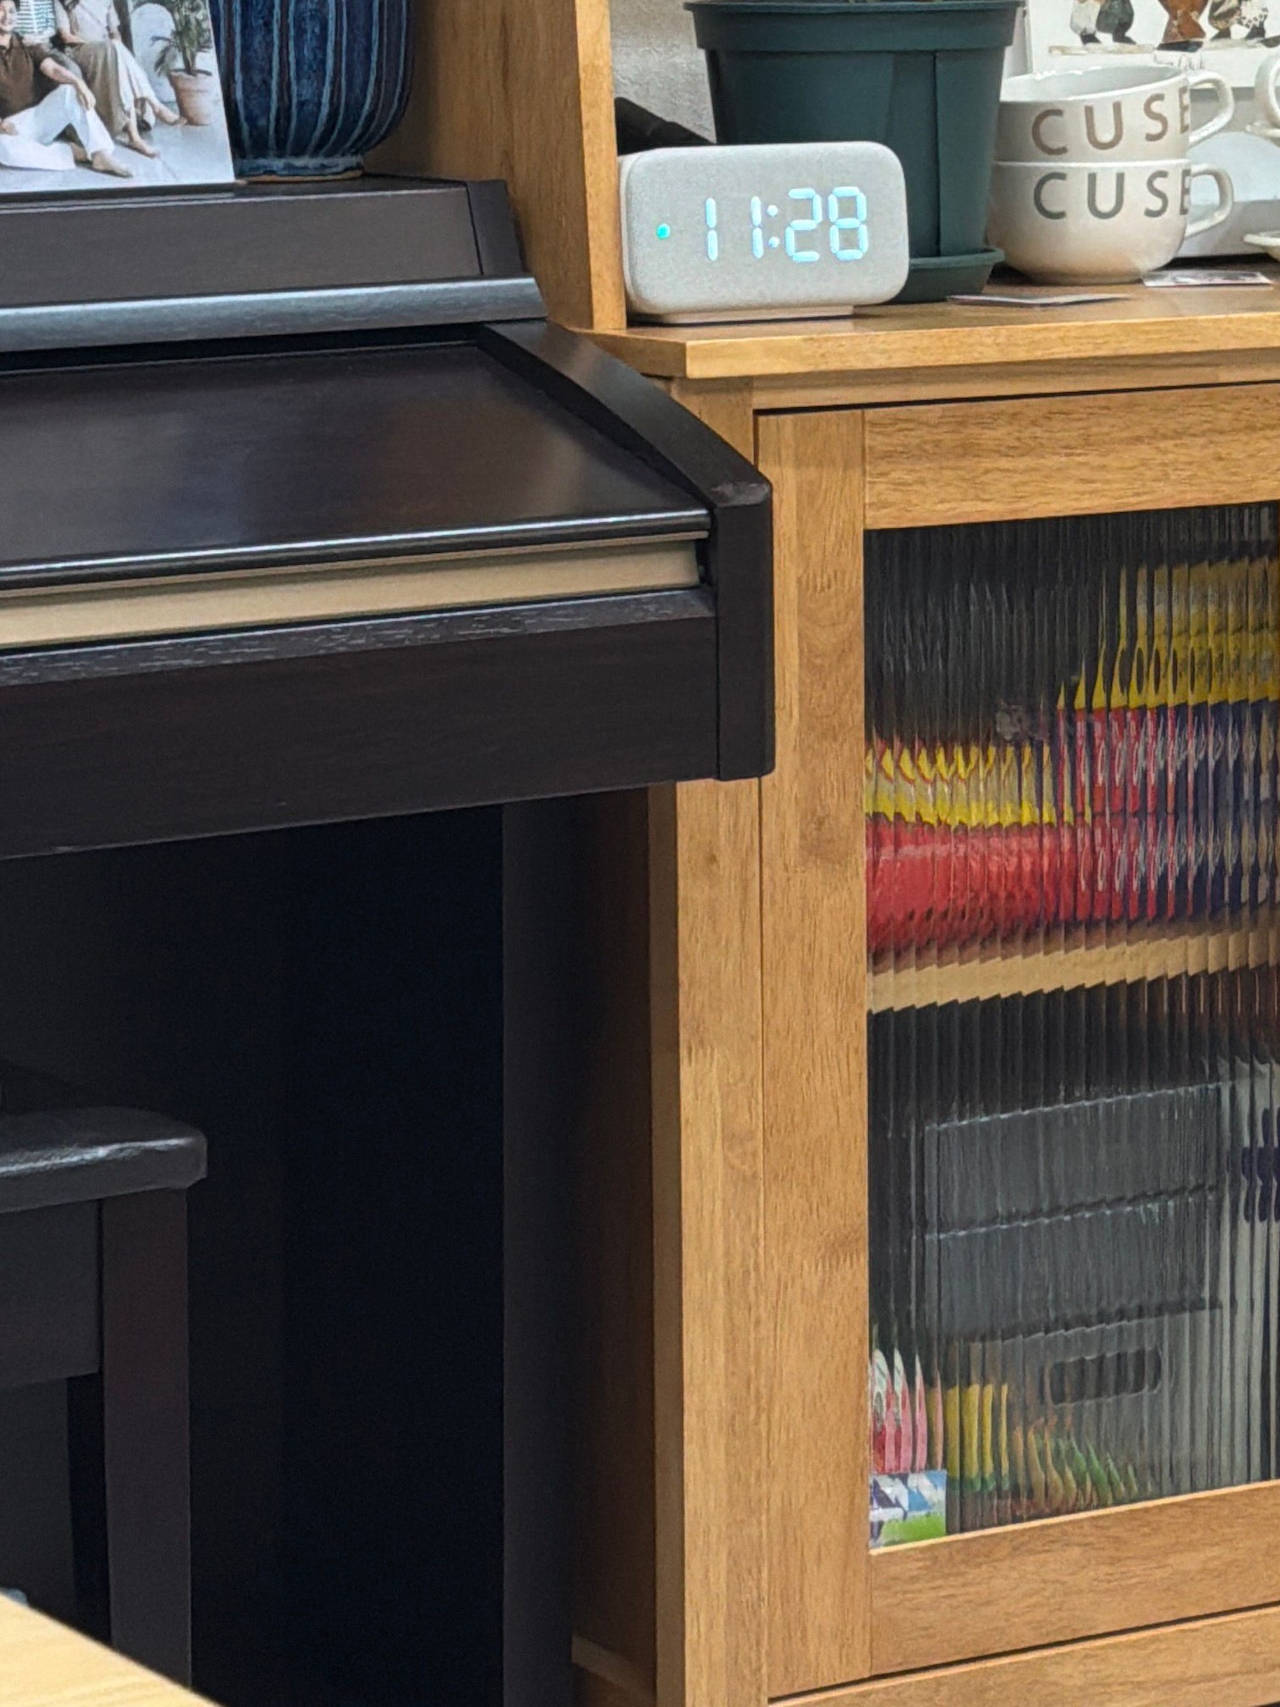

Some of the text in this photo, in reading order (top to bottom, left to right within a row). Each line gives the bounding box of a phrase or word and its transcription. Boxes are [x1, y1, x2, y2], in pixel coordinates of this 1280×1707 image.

[1032, 87, 1190, 156] CUSE
[705, 186, 868, 262] 11:28
[1033, 169, 1191, 220] CUSE
